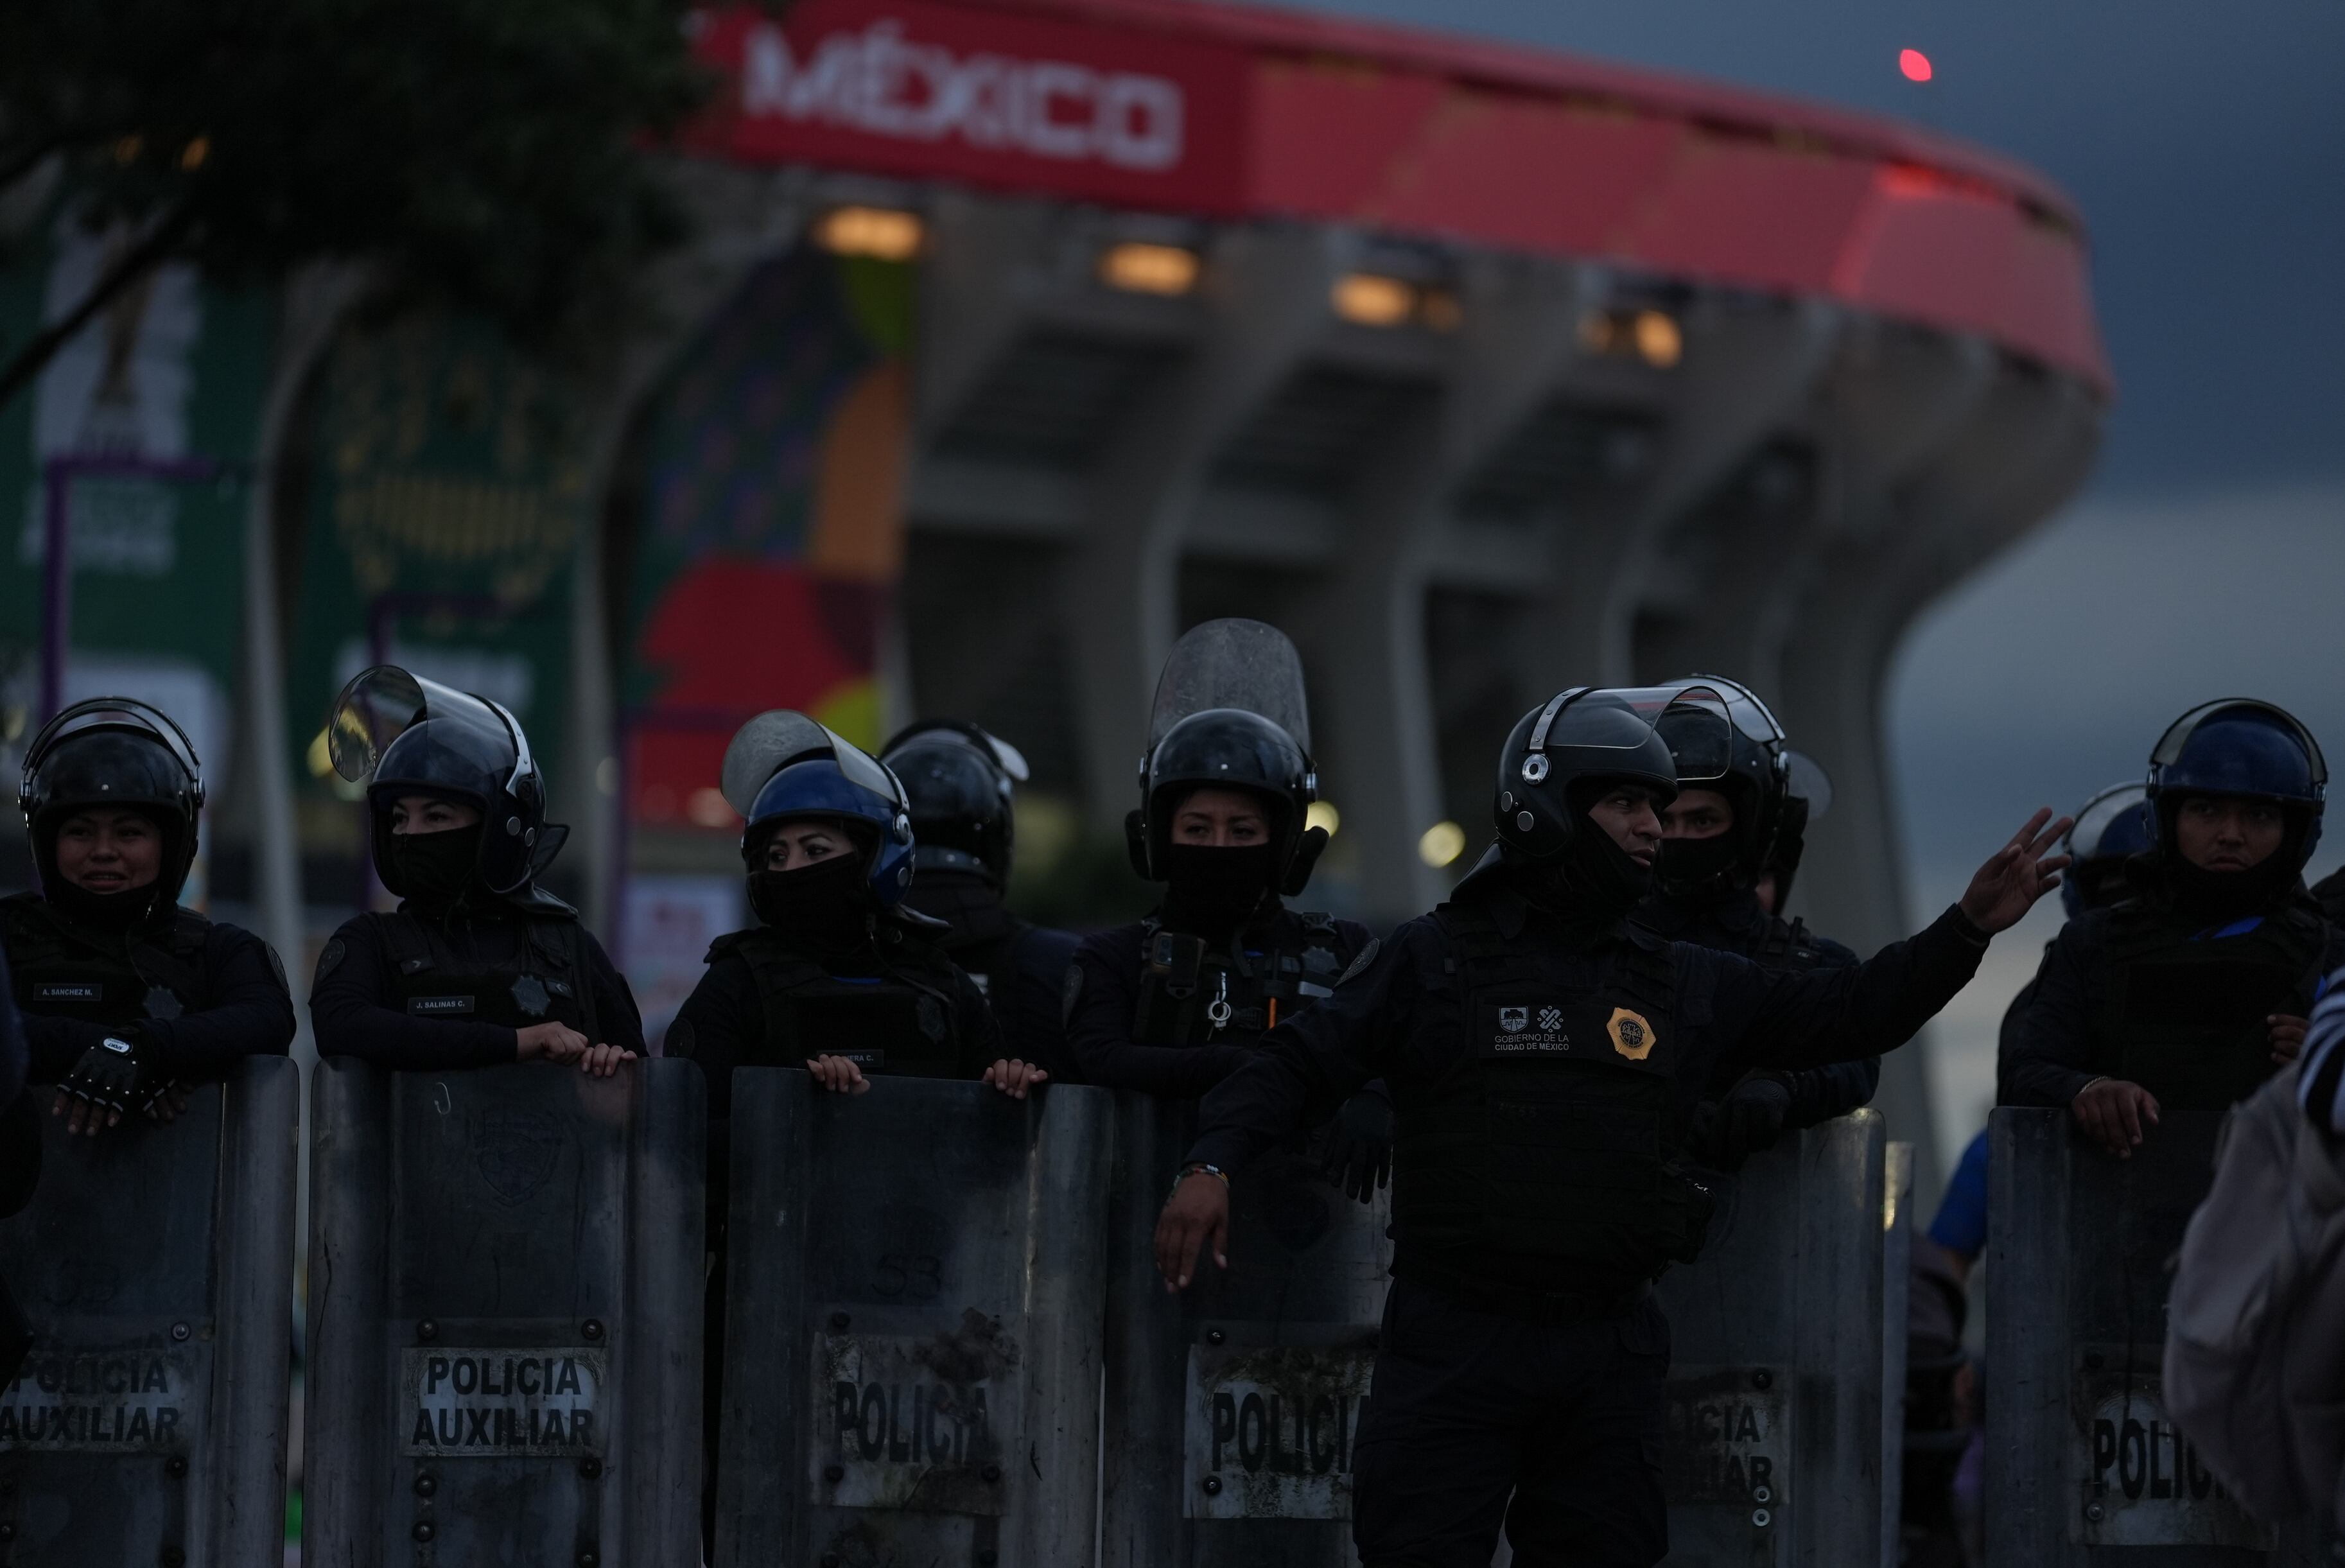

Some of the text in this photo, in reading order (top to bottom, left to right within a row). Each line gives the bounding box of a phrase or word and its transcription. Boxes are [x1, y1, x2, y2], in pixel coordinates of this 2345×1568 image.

[424, 1000, 456, 1009] SALINAS
[1495, 1033, 1542, 1043] GOBIERNO
[1539, 1041, 1569, 1050] MÉXICO
[428, 1357, 581, 1395] POLICIA
[0, 1406, 179, 1442] AUXILIAR
[412, 1409, 595, 1447] AUXILIAR
[2094, 1418, 2224, 1501] POLIC
